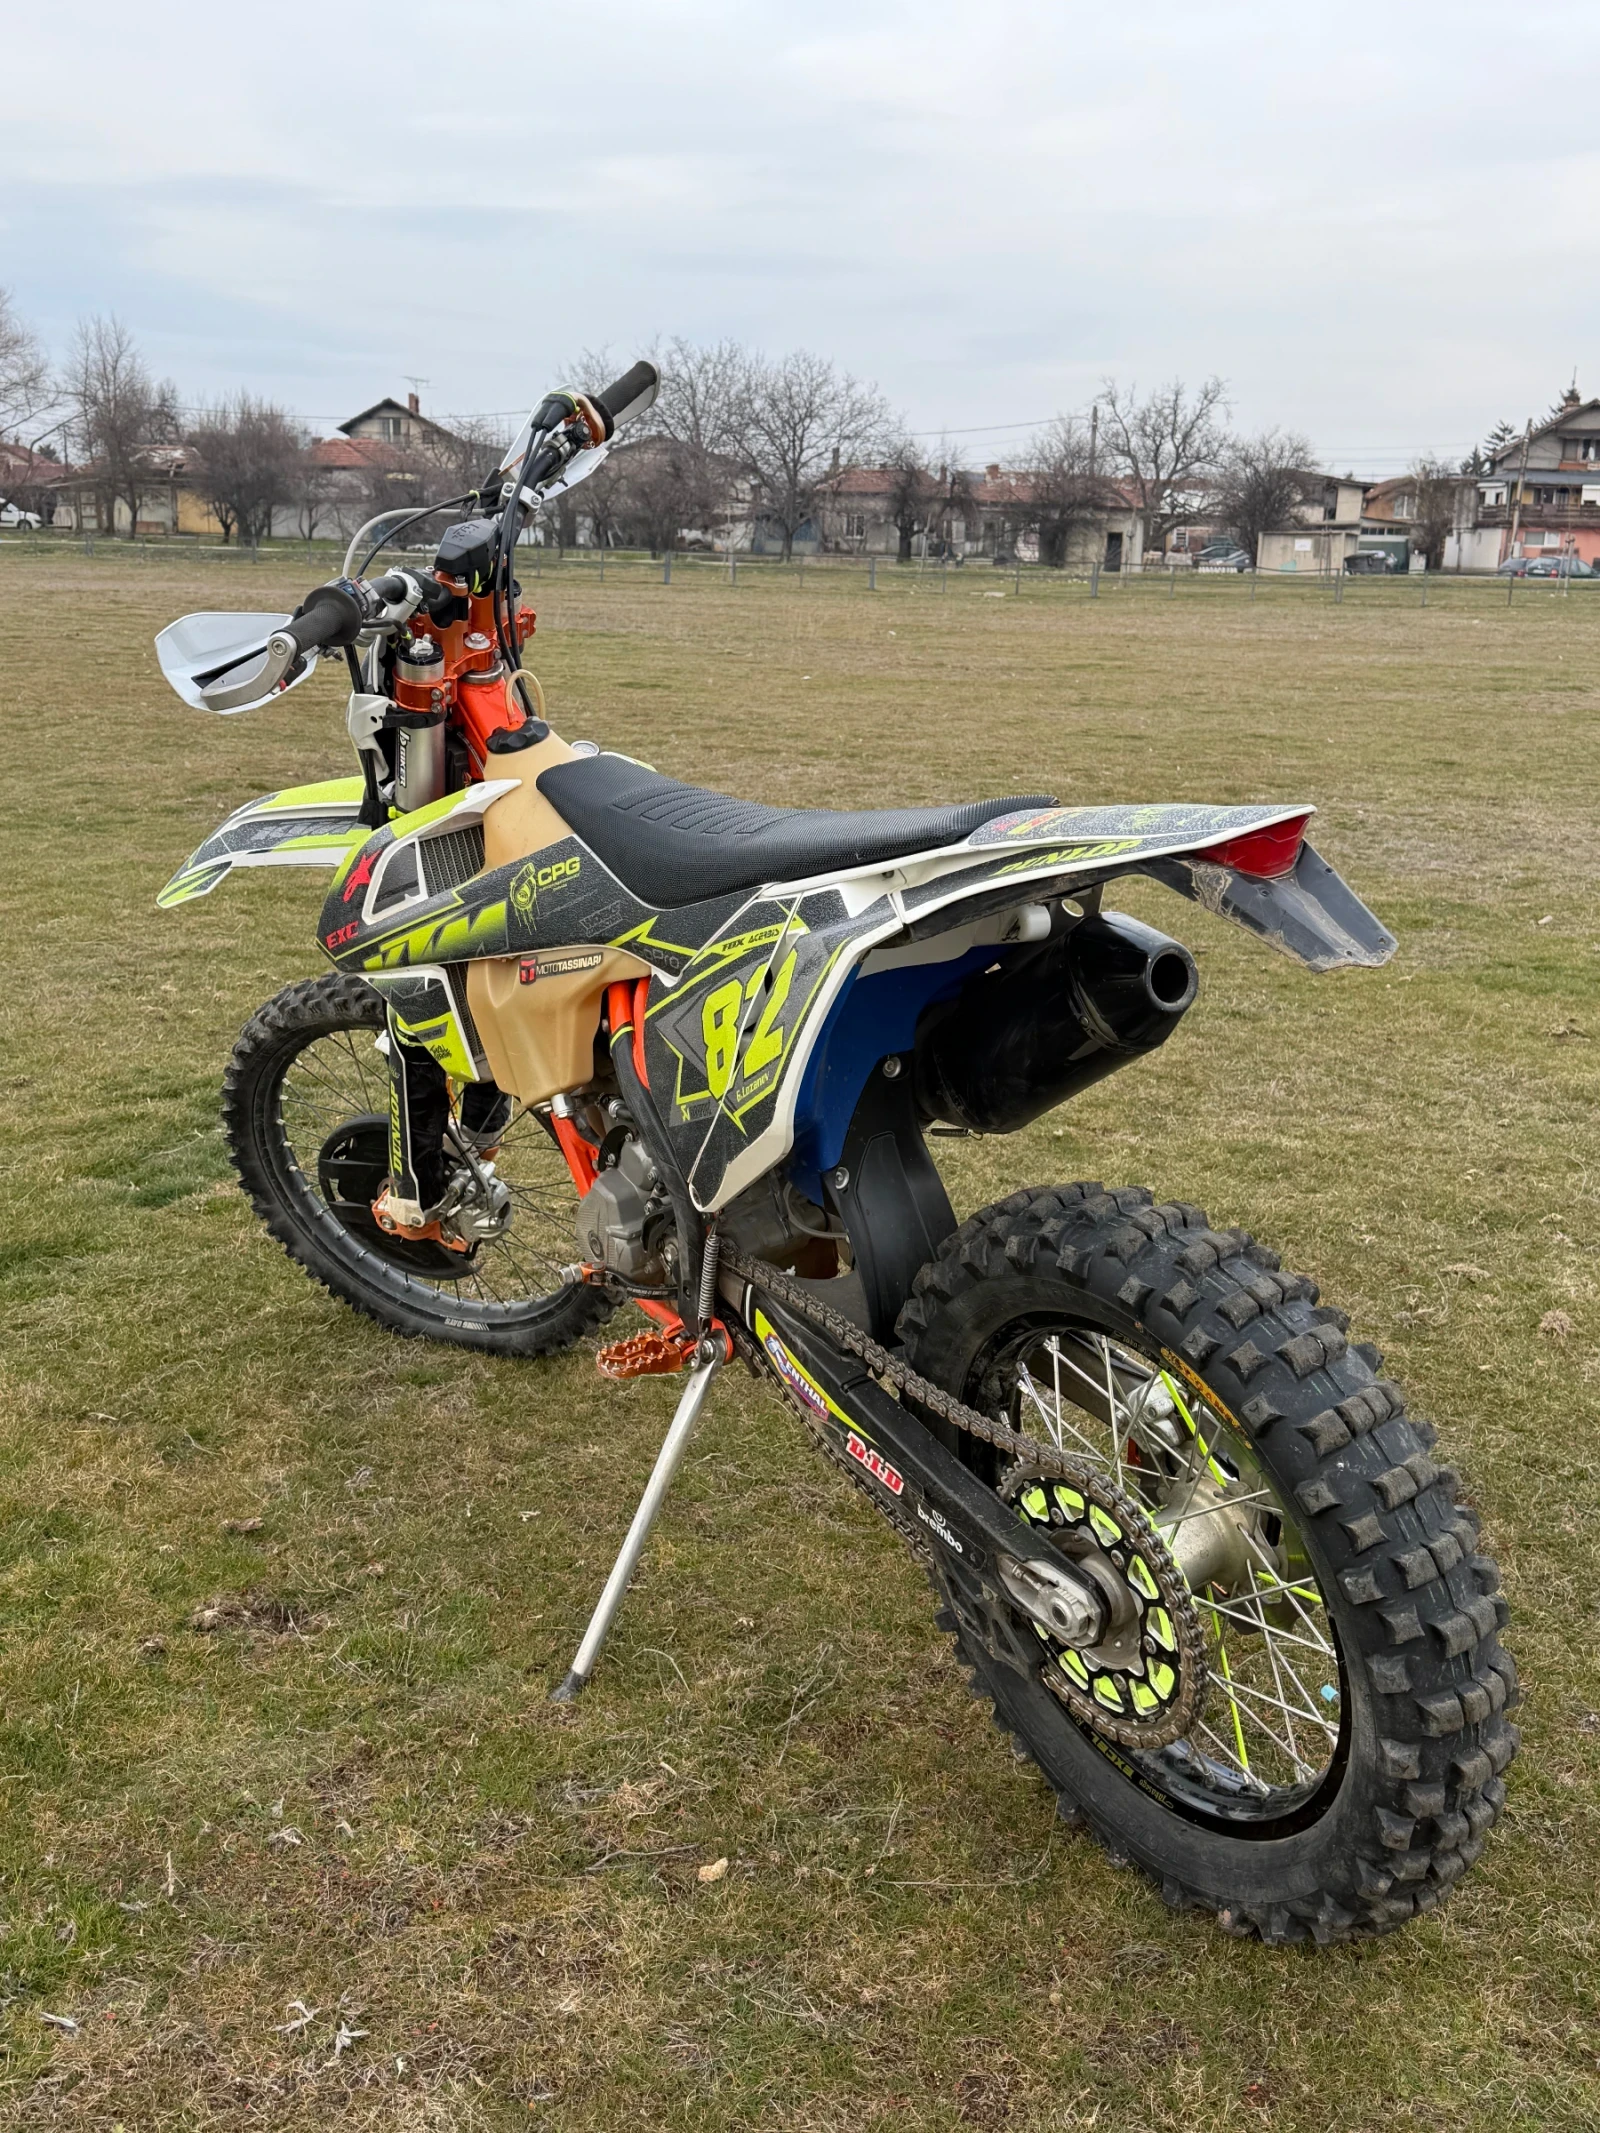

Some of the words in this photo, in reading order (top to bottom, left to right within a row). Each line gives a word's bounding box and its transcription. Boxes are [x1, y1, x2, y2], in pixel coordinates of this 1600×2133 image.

[538, 857, 580, 886] CPG
[987, 840, 1143, 877] DUNLOP
[326, 921, 359, 950] EXC
[722, 937, 745, 952] FOX
[748, 929, 780, 944] ACERBIS
[536, 955, 602, 976] MOTOTASSINARI
[701, 948, 797, 1100] 82
[390, 1080, 403, 1176] DUNLOP
[917, 1503, 963, 1553] brembo
[1091, 1731, 1135, 1779] EXCEL
